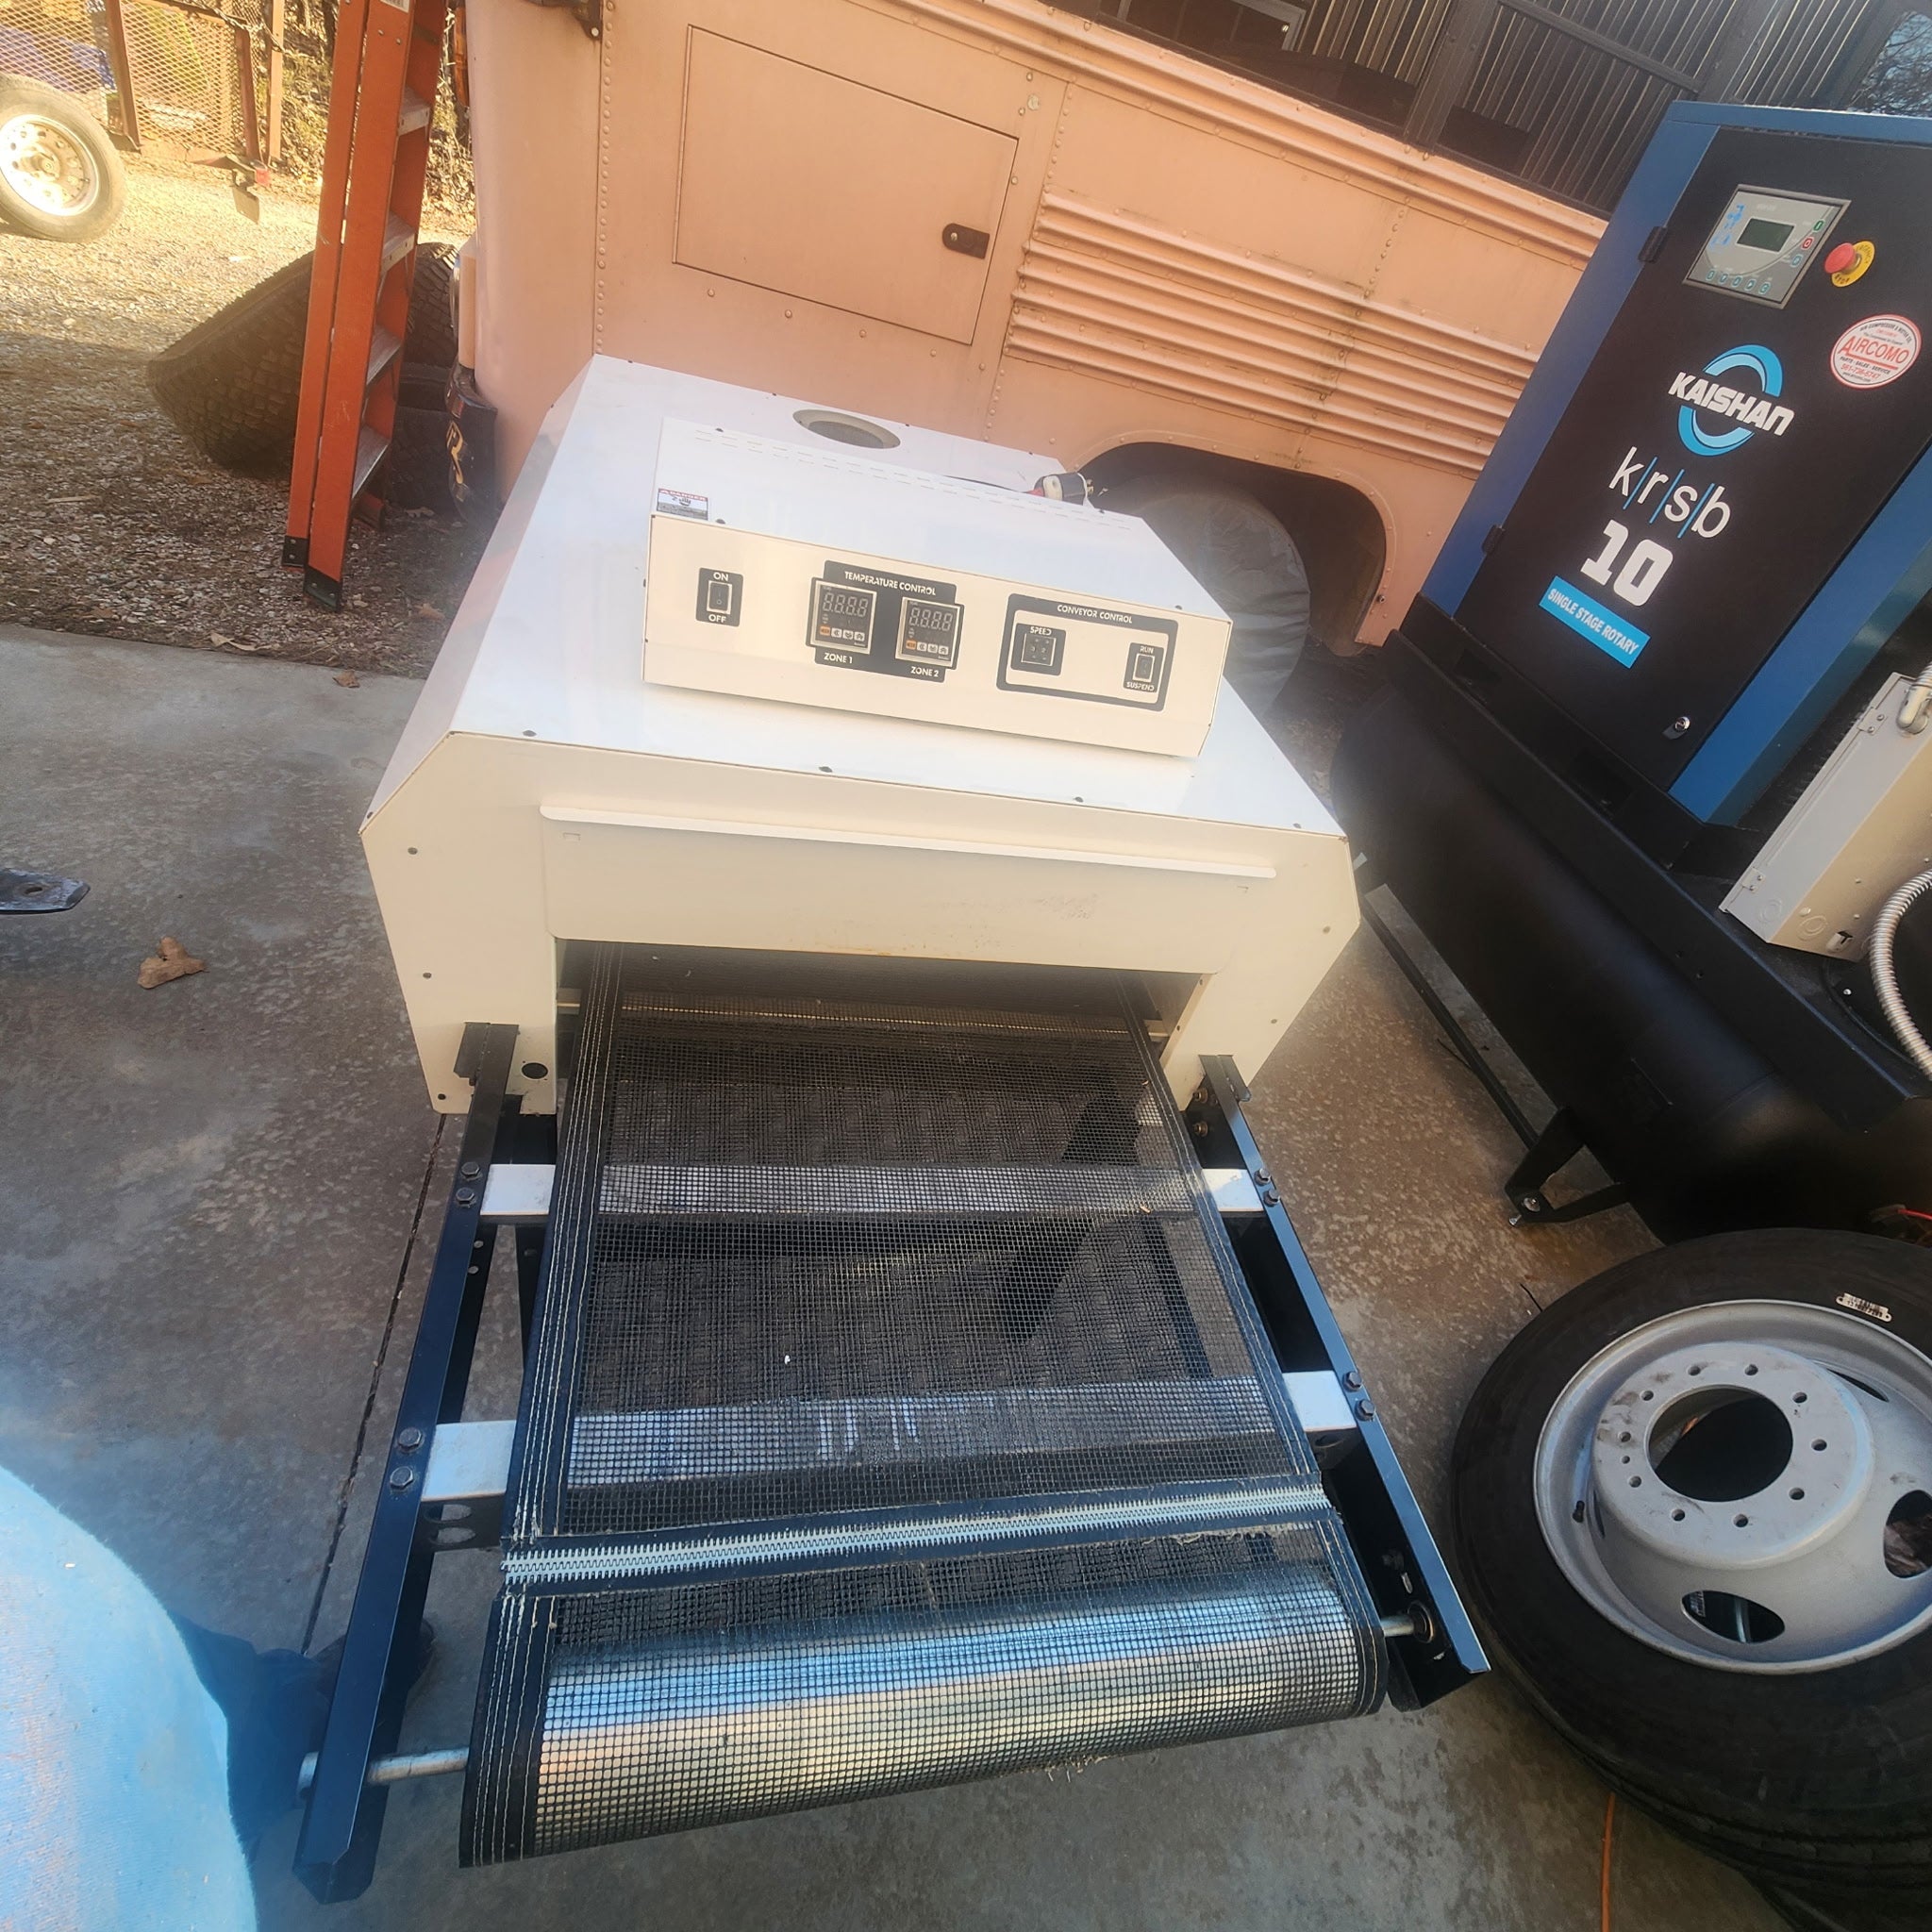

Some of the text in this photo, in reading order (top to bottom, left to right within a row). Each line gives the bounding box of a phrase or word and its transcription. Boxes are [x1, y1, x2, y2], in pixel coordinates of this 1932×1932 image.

[1837, 335, 1910, 365] AIRCOMO
[1668, 372, 1795, 437] KAISHAN
[1580, 519, 1674, 607] 10
[713, 572, 729, 582] ON
[844, 571, 937, 596] TEMPERATURE CONTROL
[708, 613, 726, 624] OFF
[1057, 604, 1133, 624] CONVEYOR CONTROL
[1548, 588, 1640, 656] SINGLE STAGE ROTARY
[1029, 625, 1052, 636] SPEED
[1140, 645, 1155, 655] RUN
[824, 652, 854, 664] ZONE 1
[910, 666, 940, 677] ZONE 2
[1125, 680, 1156, 692] SUSPEND
